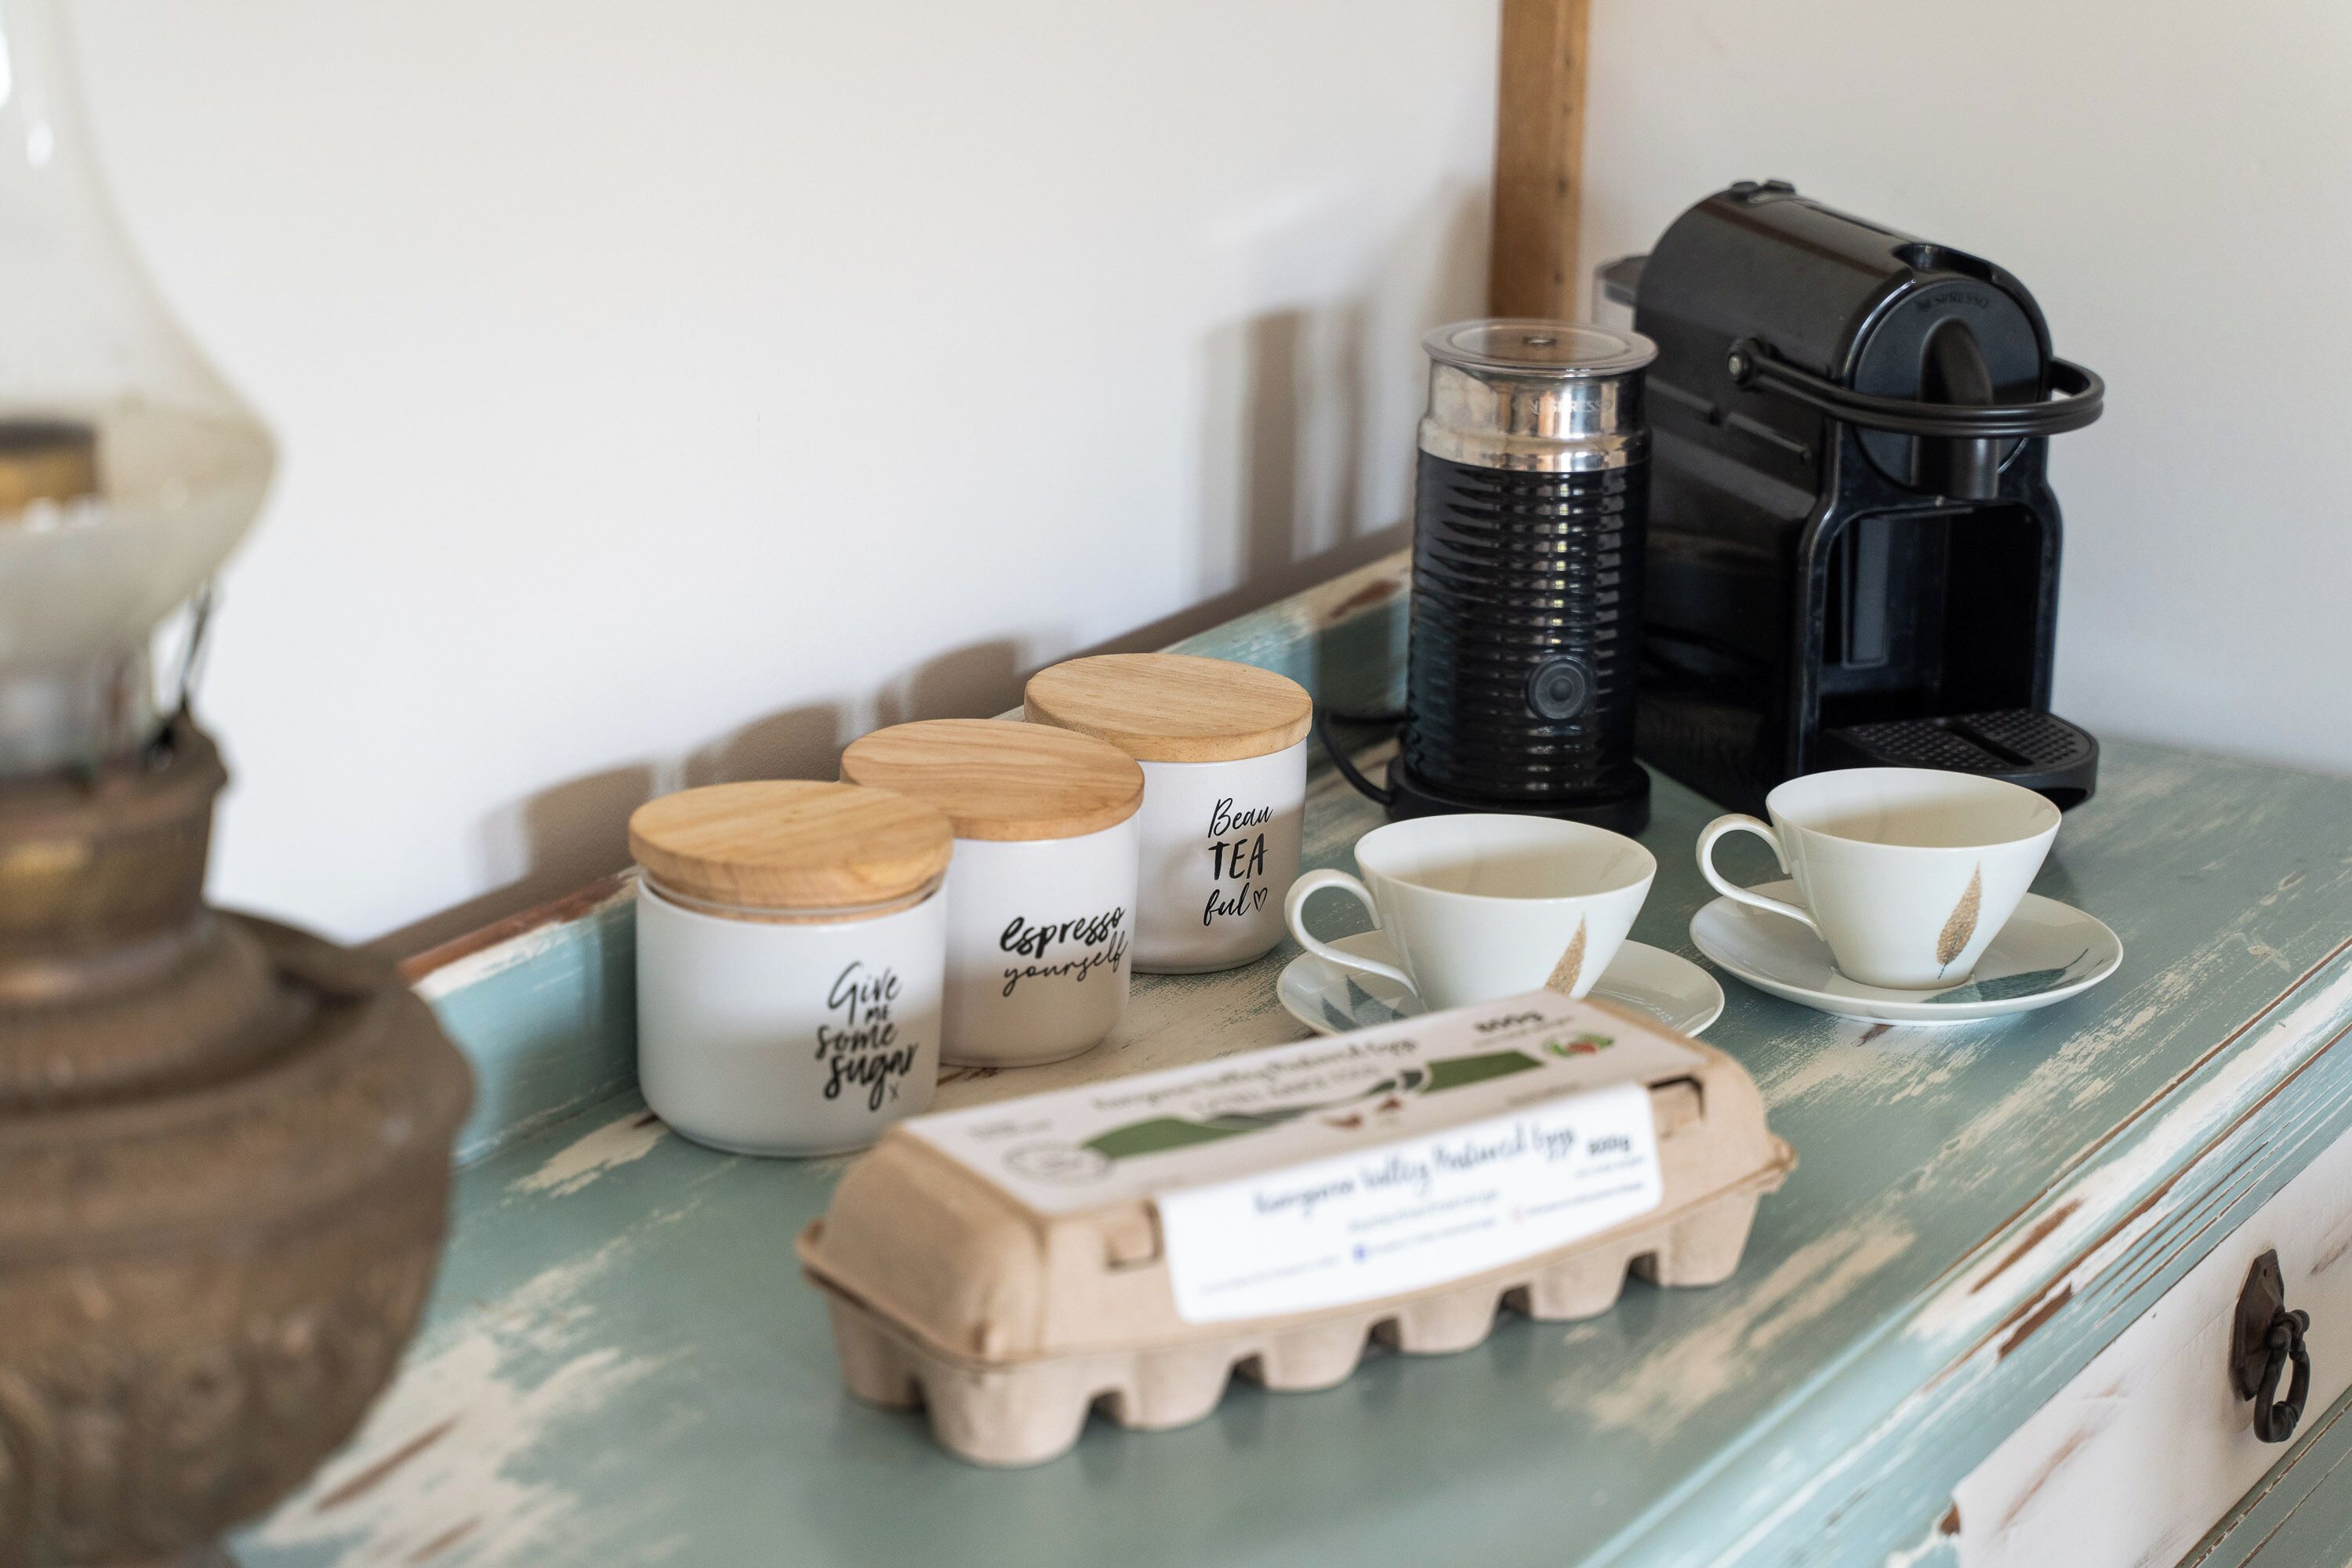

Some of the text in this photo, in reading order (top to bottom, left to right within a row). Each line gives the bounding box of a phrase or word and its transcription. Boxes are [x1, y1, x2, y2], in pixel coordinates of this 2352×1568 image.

[1207, 797, 1273, 838] Beau
[1207, 833, 1269, 880] TEA
[1203, 882, 1251, 927] ful
[1000, 906, 1126, 960] espresso
[1002, 930, 1129, 997] yourself
[828, 960, 902, 1025] Give
